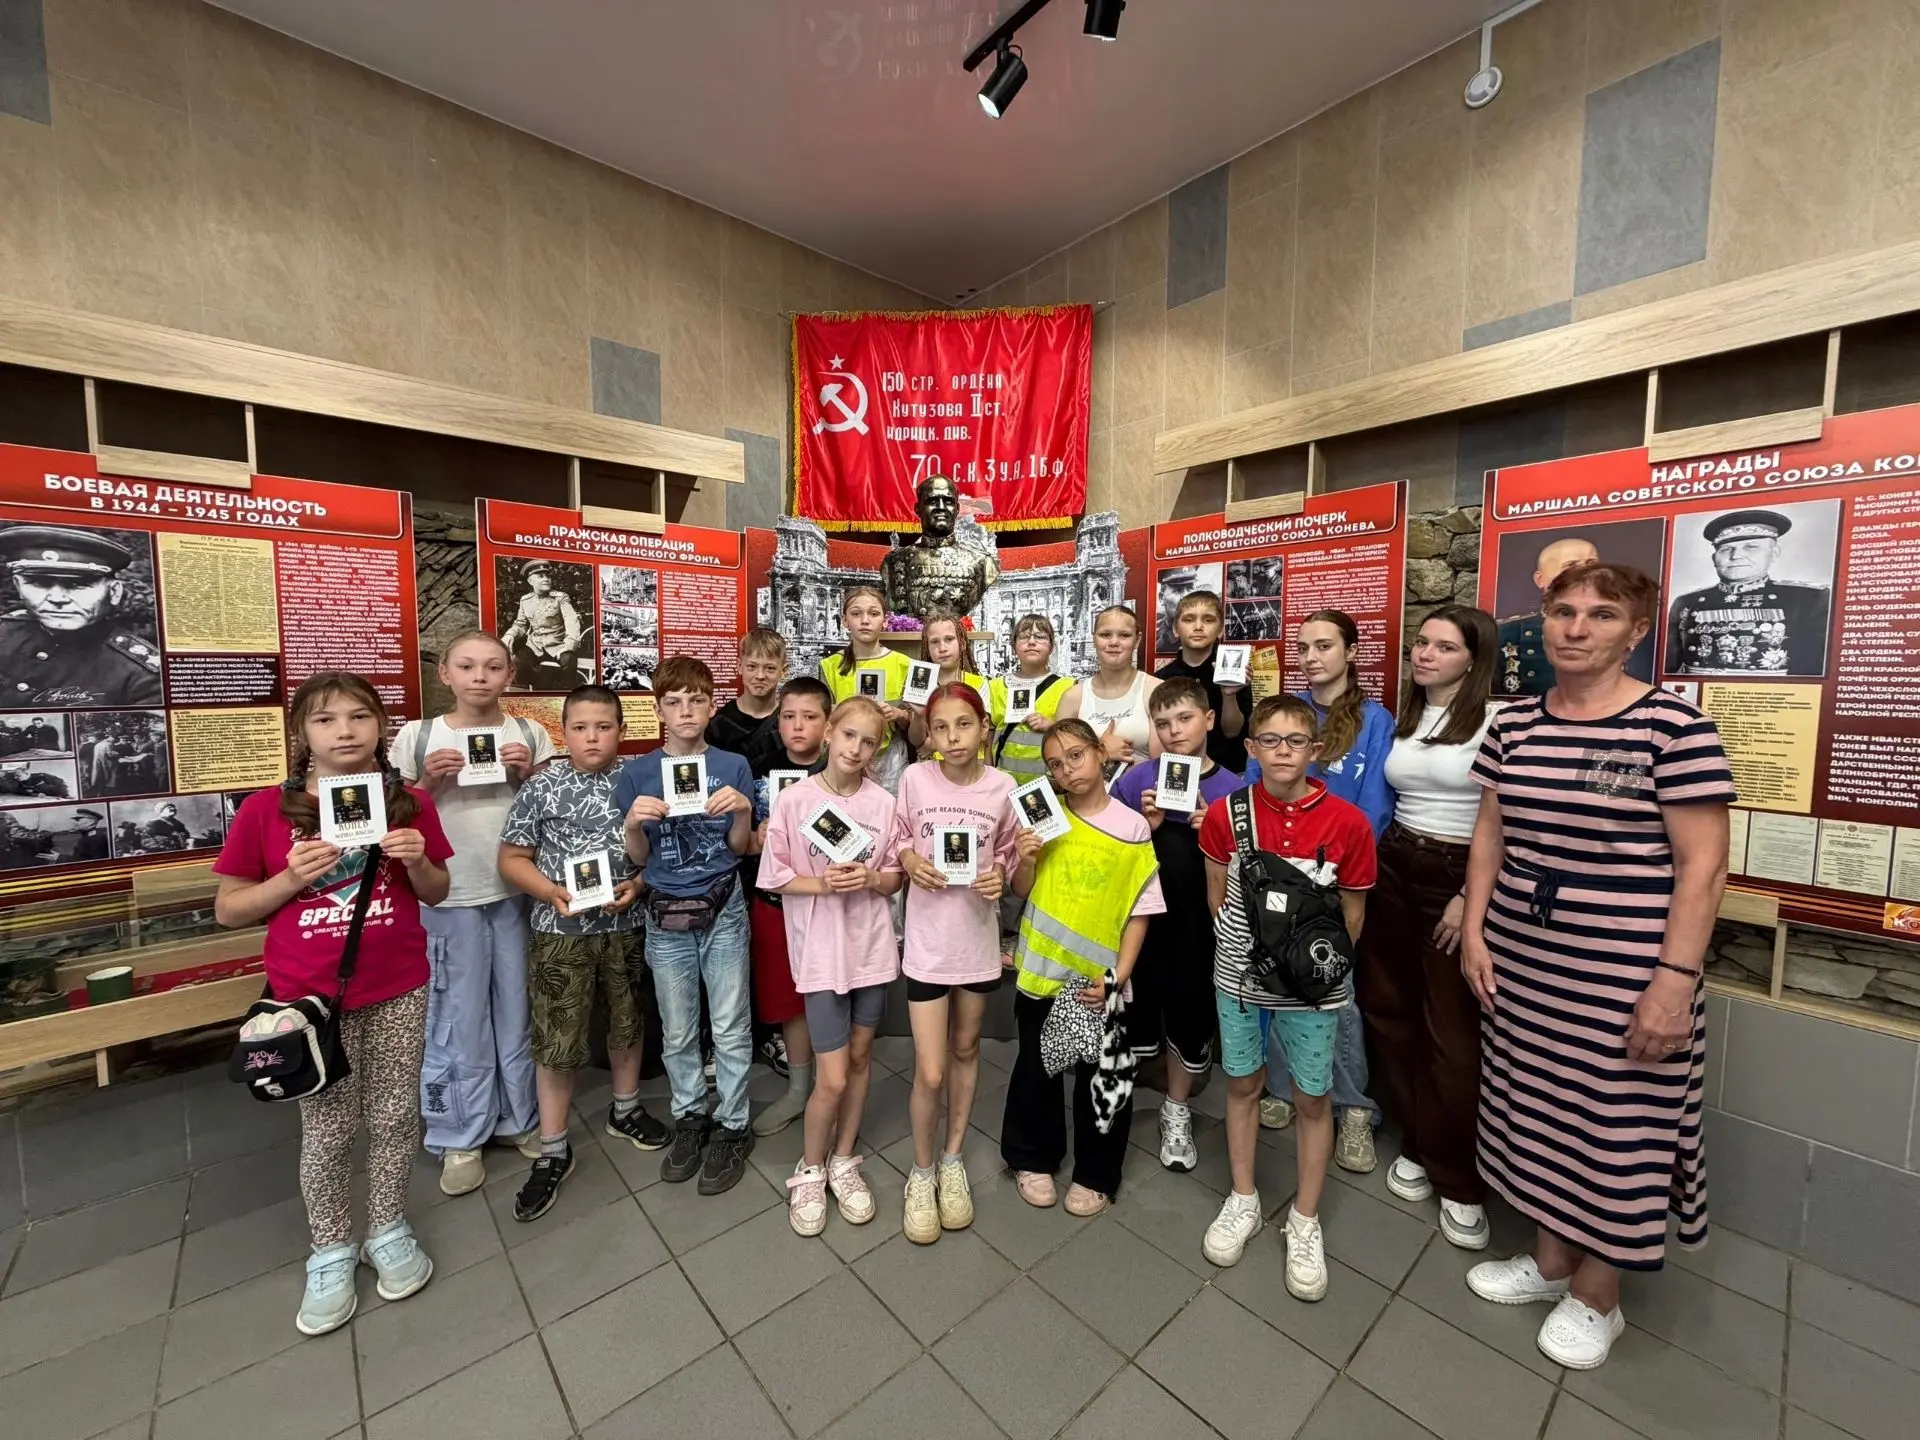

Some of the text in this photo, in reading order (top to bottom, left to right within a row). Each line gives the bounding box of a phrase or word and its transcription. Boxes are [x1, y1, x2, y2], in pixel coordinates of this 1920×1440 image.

[882, 372, 904, 392] 150
[1650, 451, 1781, 485] НАГРАДЫ
[1507, 453, 1920, 515] МАРШАЛА СОВЕТСКОГО СОЮЗА КО
[44, 473, 327, 516] БОЕВАЯ ДЕЯТЕЛЬНОСТЬ
[1879, 491, 1913, 500] КОНЕВ
[90, 497, 104, 509] В
[111, 498, 161, 514] 1944
[185, 505, 230, 520] 1945
[237, 511, 300, 527] ГОДАХ
[1183, 511, 1347, 544] ПОЛКОВОДЧЕСКИЙ ПОЧЕРК
[1851, 523, 1899, 532] ДВАЖДЫ
[549, 525, 695, 552] ПРАЖСКАЯ ОПЕРАЦИЯ
[1166, 521, 1375, 556] МАРШАЛА СОВЕТСКОГО СОЮЗА КОНЕВА
[515, 533, 720, 565] ВОЙСК 1-ГО УКРАИНСКОГО ФРОНТА
[1850, 548, 1883, 557] ОРДЕН
[1836, 692, 1892, 700] НАРОДНОЙ
[1835, 710, 1890, 718] НАРОДНОЙ
[1832, 733, 1901, 743] ТАКЖЕ ИВАН
[1832, 742, 1894, 752] КОНЕВ БЫЛ
[1831, 751, 1891, 761] МЕДАЛЯМИ
[1830, 760, 1913, 772] ДАРСТВЕННЫМИ
[1856, 797, 1918, 808] МОНГОЛИИ
[917, 809, 924, 817] BE
[940, 806, 966, 814] REASON
[968, 809, 997, 824] SOMEONE
[298, 897, 394, 927] SPECAL
